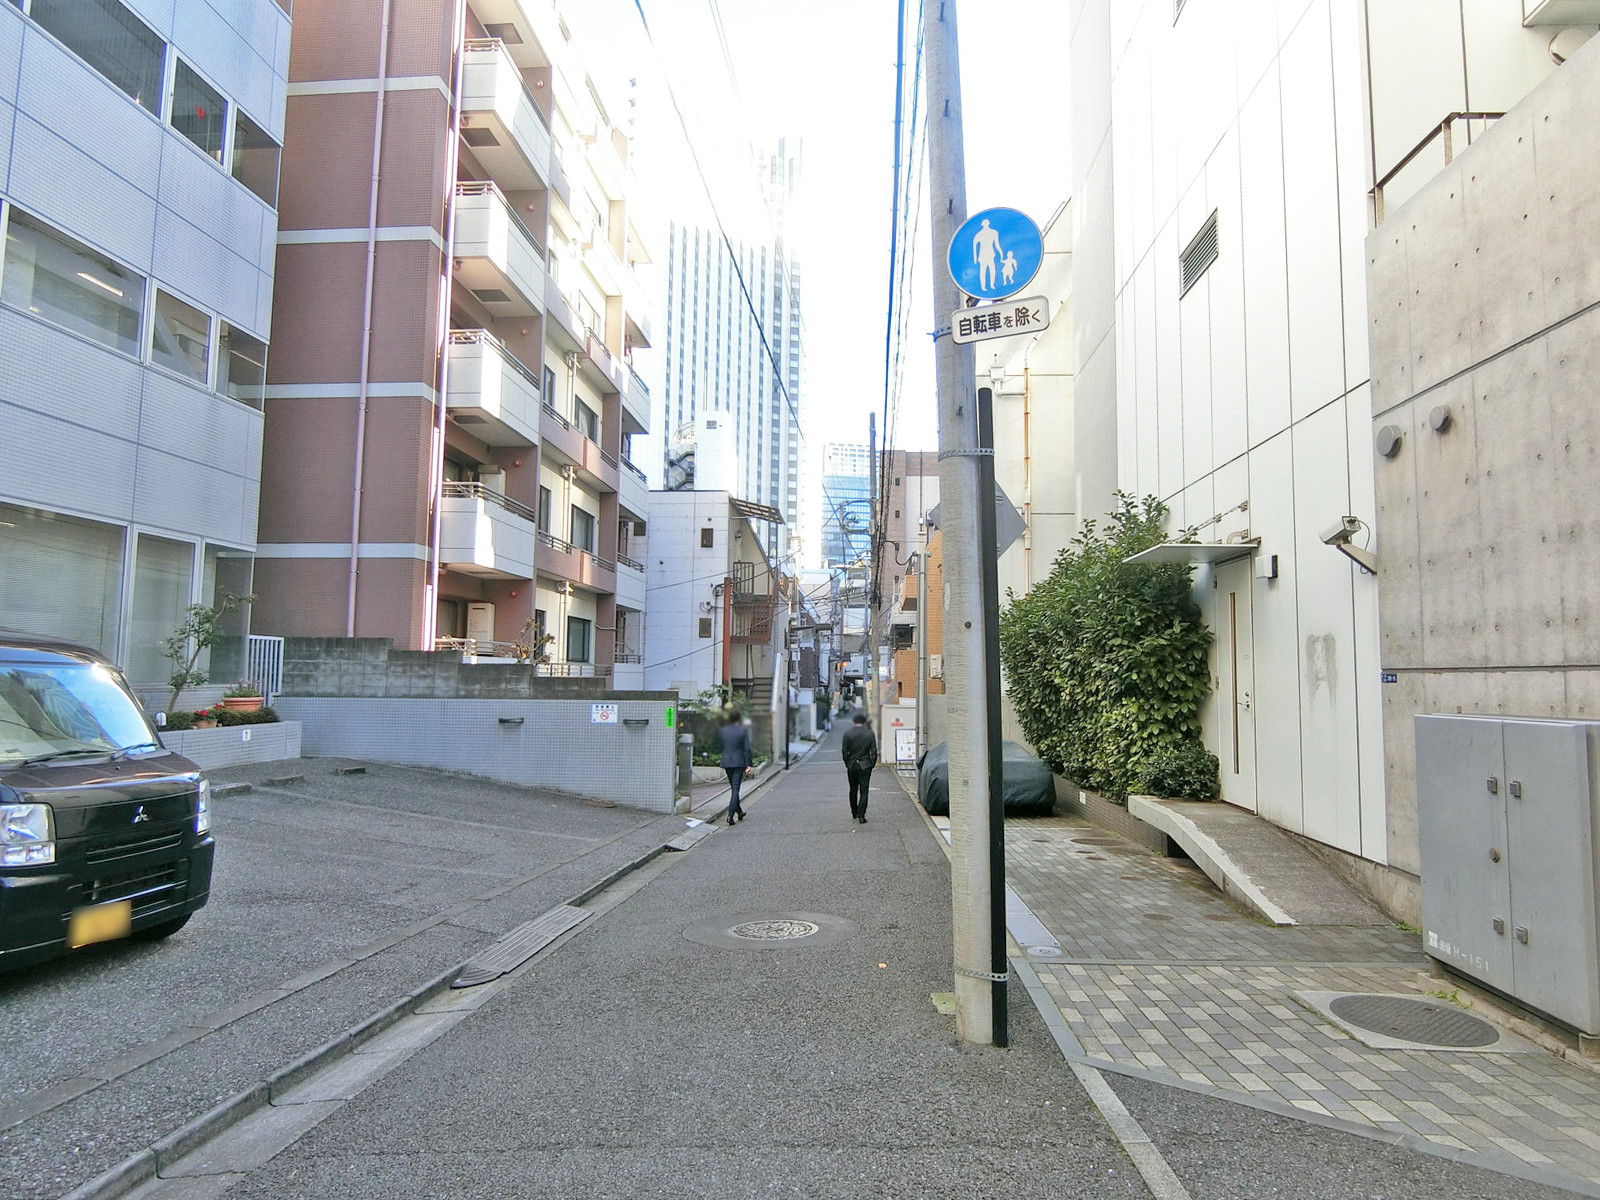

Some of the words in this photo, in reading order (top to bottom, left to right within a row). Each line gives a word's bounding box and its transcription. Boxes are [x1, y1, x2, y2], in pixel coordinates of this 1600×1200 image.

[959, 306, 1041, 337] 自転車を除く
